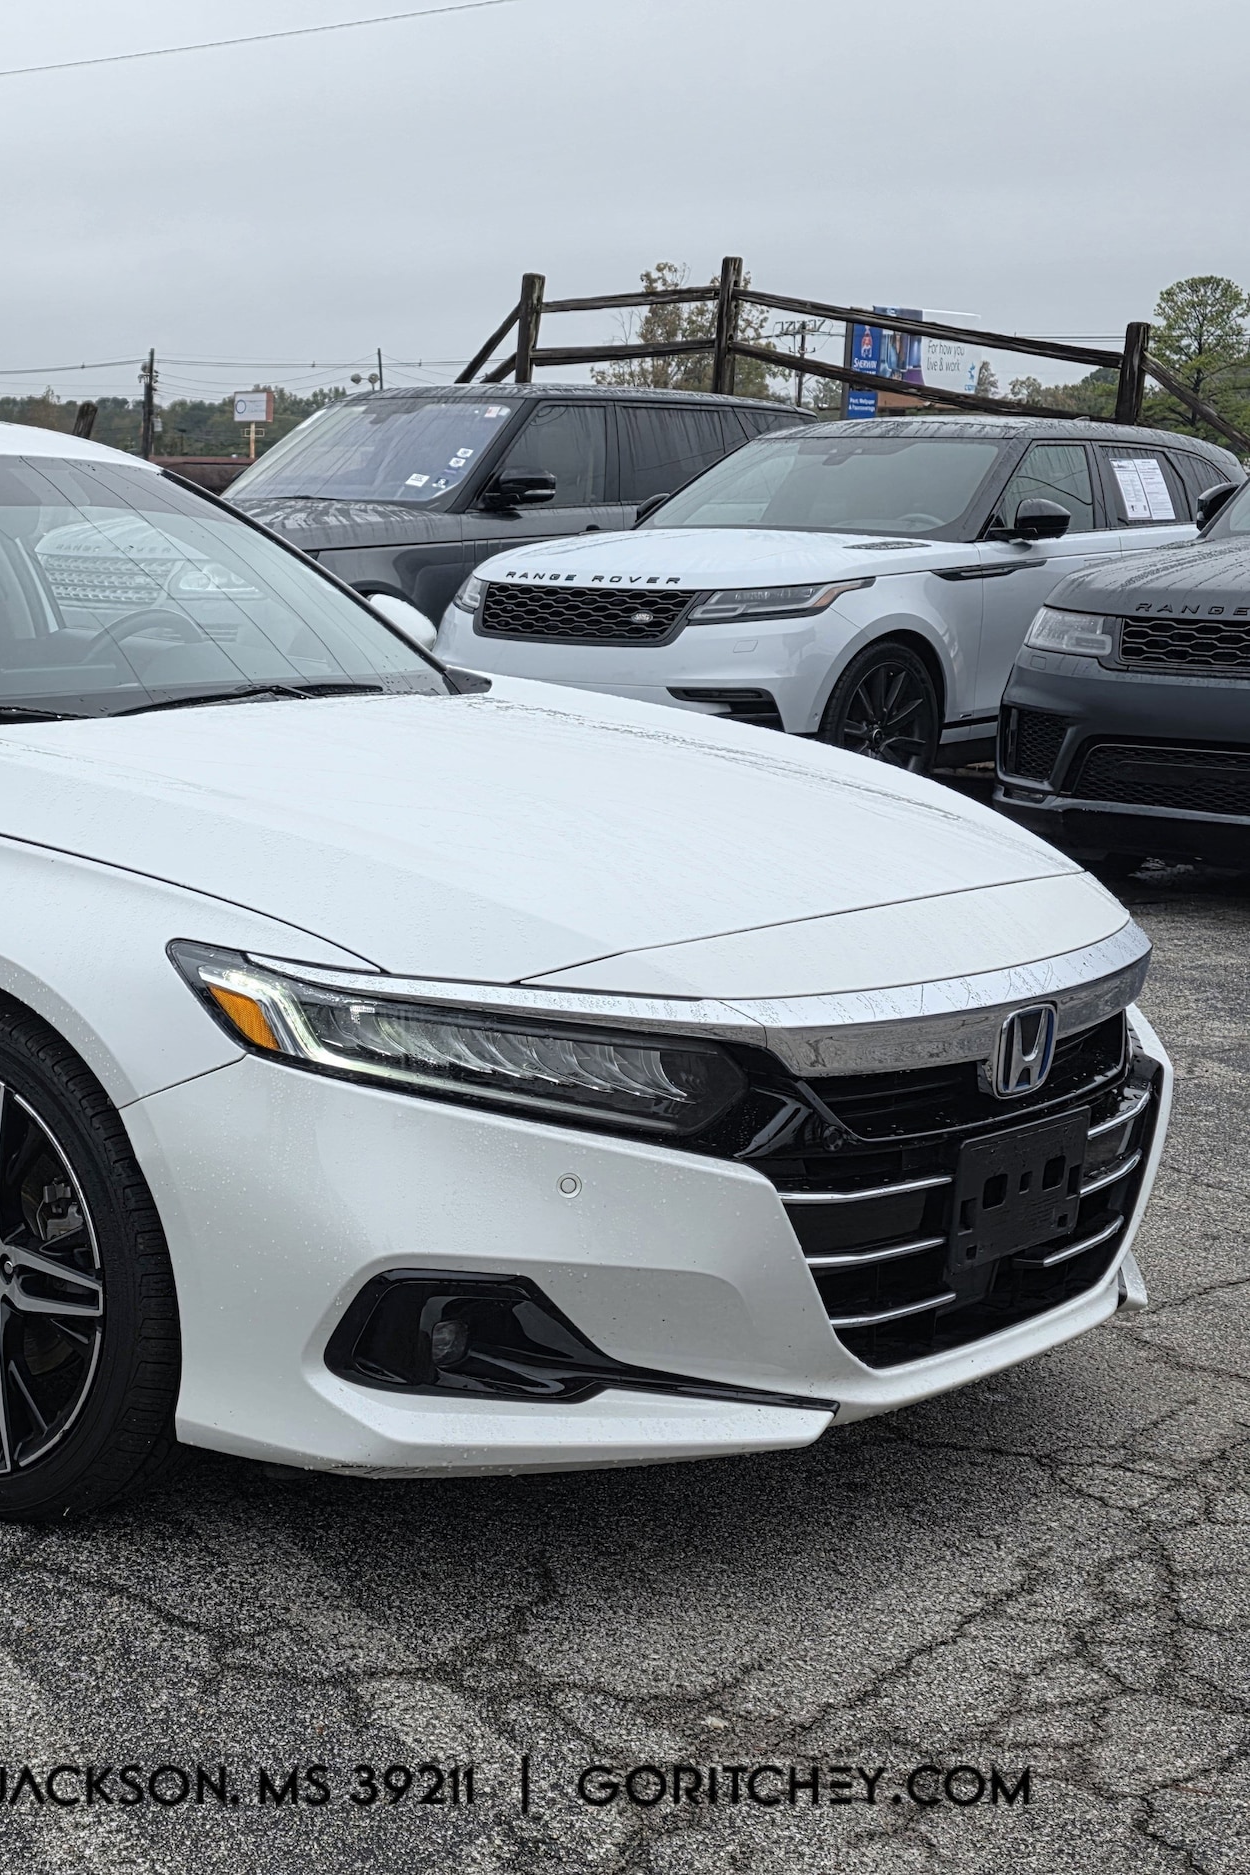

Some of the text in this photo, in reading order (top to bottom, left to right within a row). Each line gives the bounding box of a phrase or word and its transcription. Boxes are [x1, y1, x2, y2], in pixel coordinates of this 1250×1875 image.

[927, 339, 965, 359] For how you
[926, 356, 938, 371] live
[945, 359, 961, 371] work
[505, 571, 681, 585] RANGE ROVER
[1135, 603, 1250, 616] RANGE
